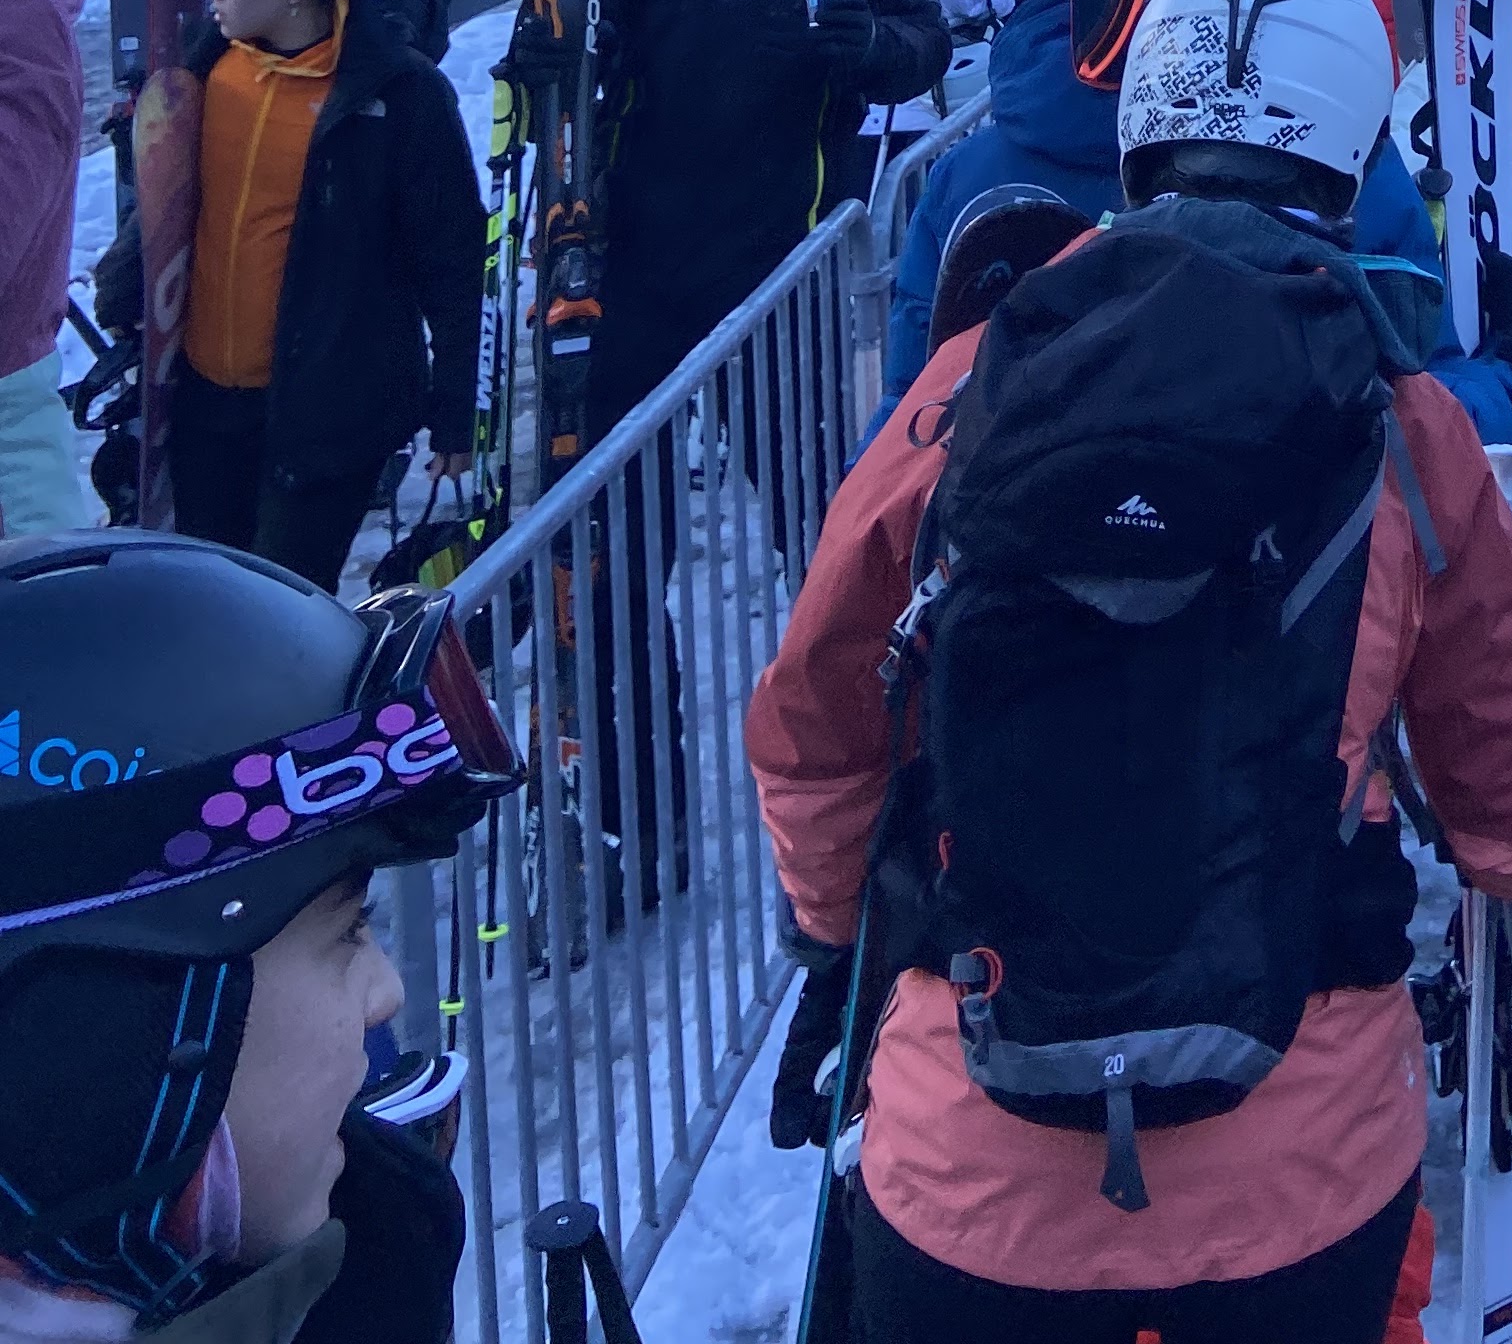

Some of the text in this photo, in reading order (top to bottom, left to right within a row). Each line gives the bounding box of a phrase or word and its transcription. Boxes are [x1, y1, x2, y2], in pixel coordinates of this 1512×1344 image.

[1454, 3, 1468, 76] SWISS
[1104, 515, 1166, 530] QUECHUA
[1103, 1053, 1125, 1077] 20
